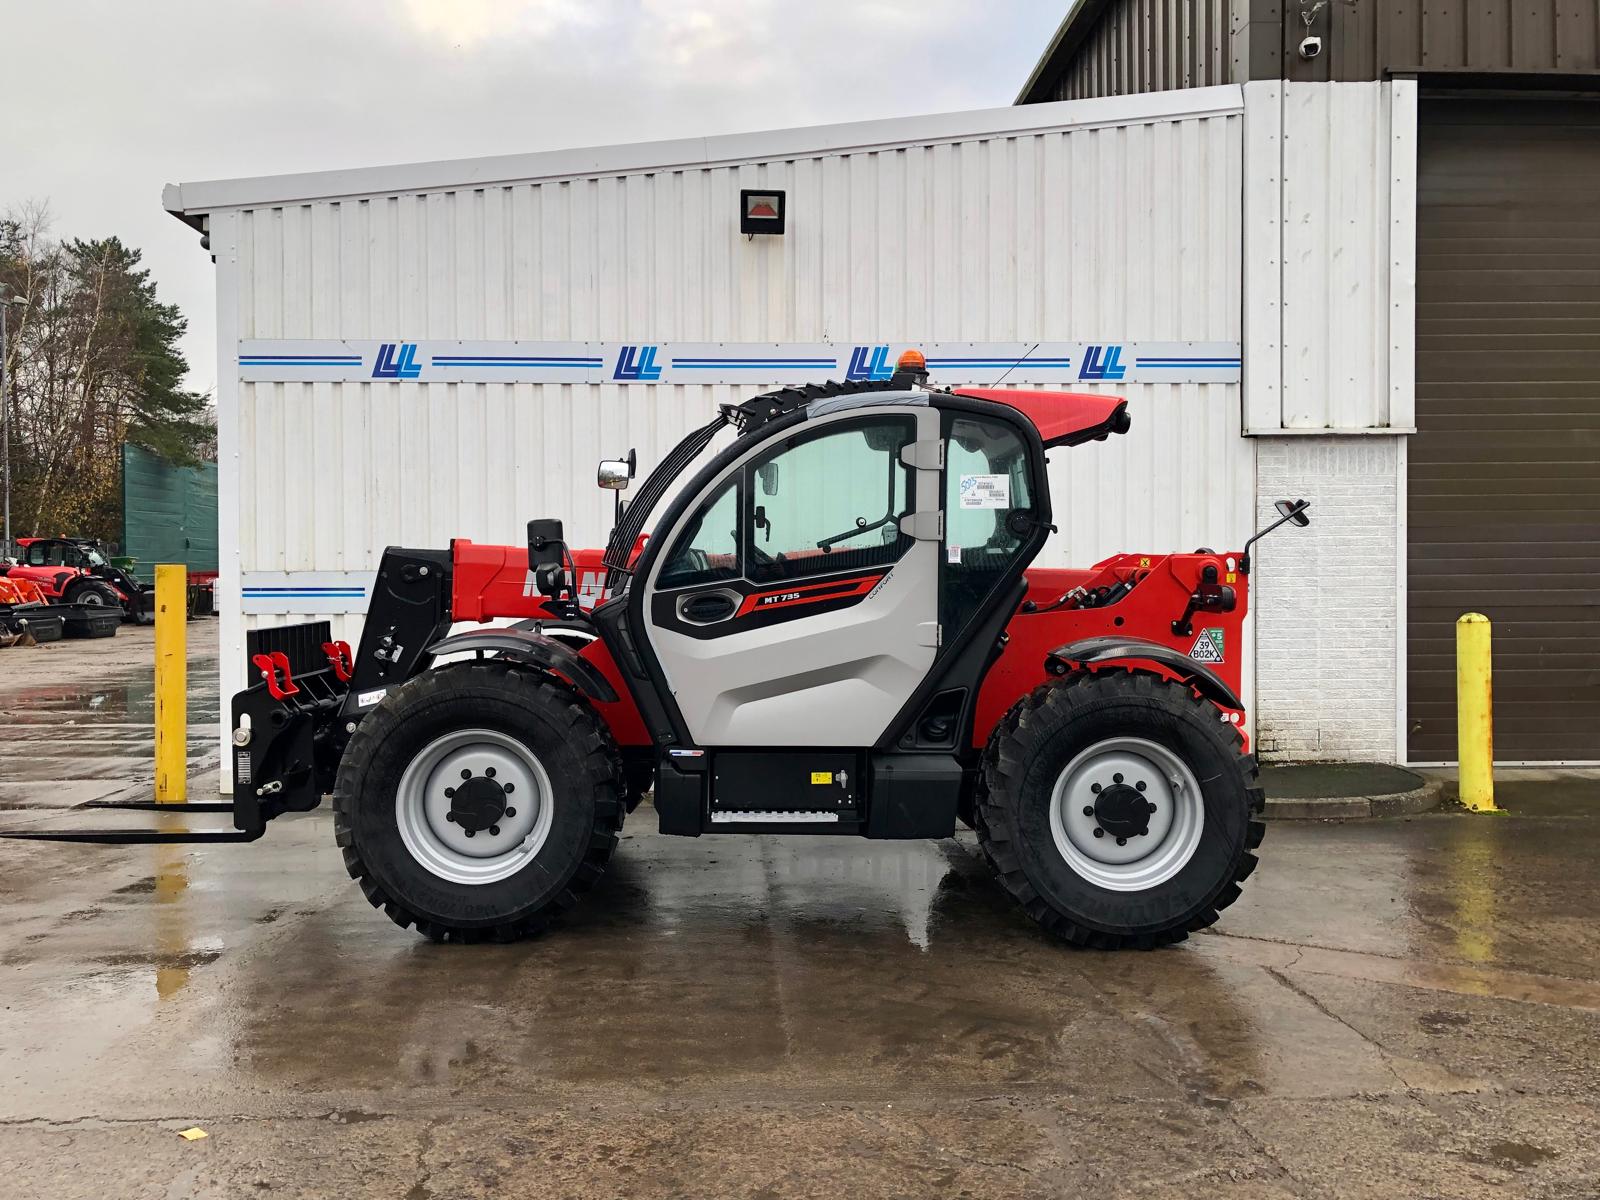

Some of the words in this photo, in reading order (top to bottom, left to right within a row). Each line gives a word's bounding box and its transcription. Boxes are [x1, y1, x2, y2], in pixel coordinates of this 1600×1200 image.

[764, 595, 779, 604] MT
[780, 592, 800, 602] 735
[1199, 641, 1210, 650] 39
